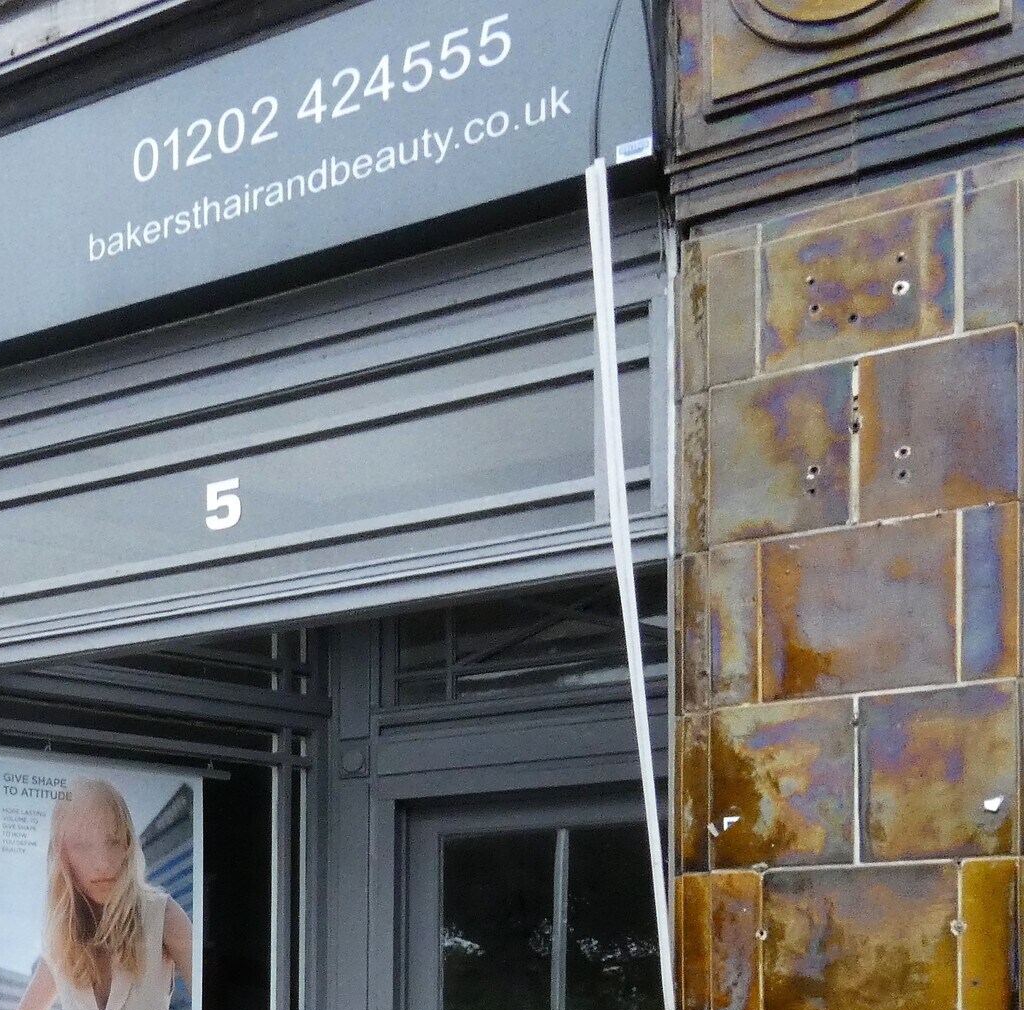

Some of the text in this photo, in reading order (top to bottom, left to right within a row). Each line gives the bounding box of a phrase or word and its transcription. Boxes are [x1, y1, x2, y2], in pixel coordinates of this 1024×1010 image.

[133, 13, 513, 183] 01202 424555
[88, 86, 572, 262] bakersthairandbeauty.co.uk
[205, 477, 241, 531] 5
[2, 772, 67, 788] GIVE SHAPE
[2, 785, 72, 802] TO ATTITUDE
